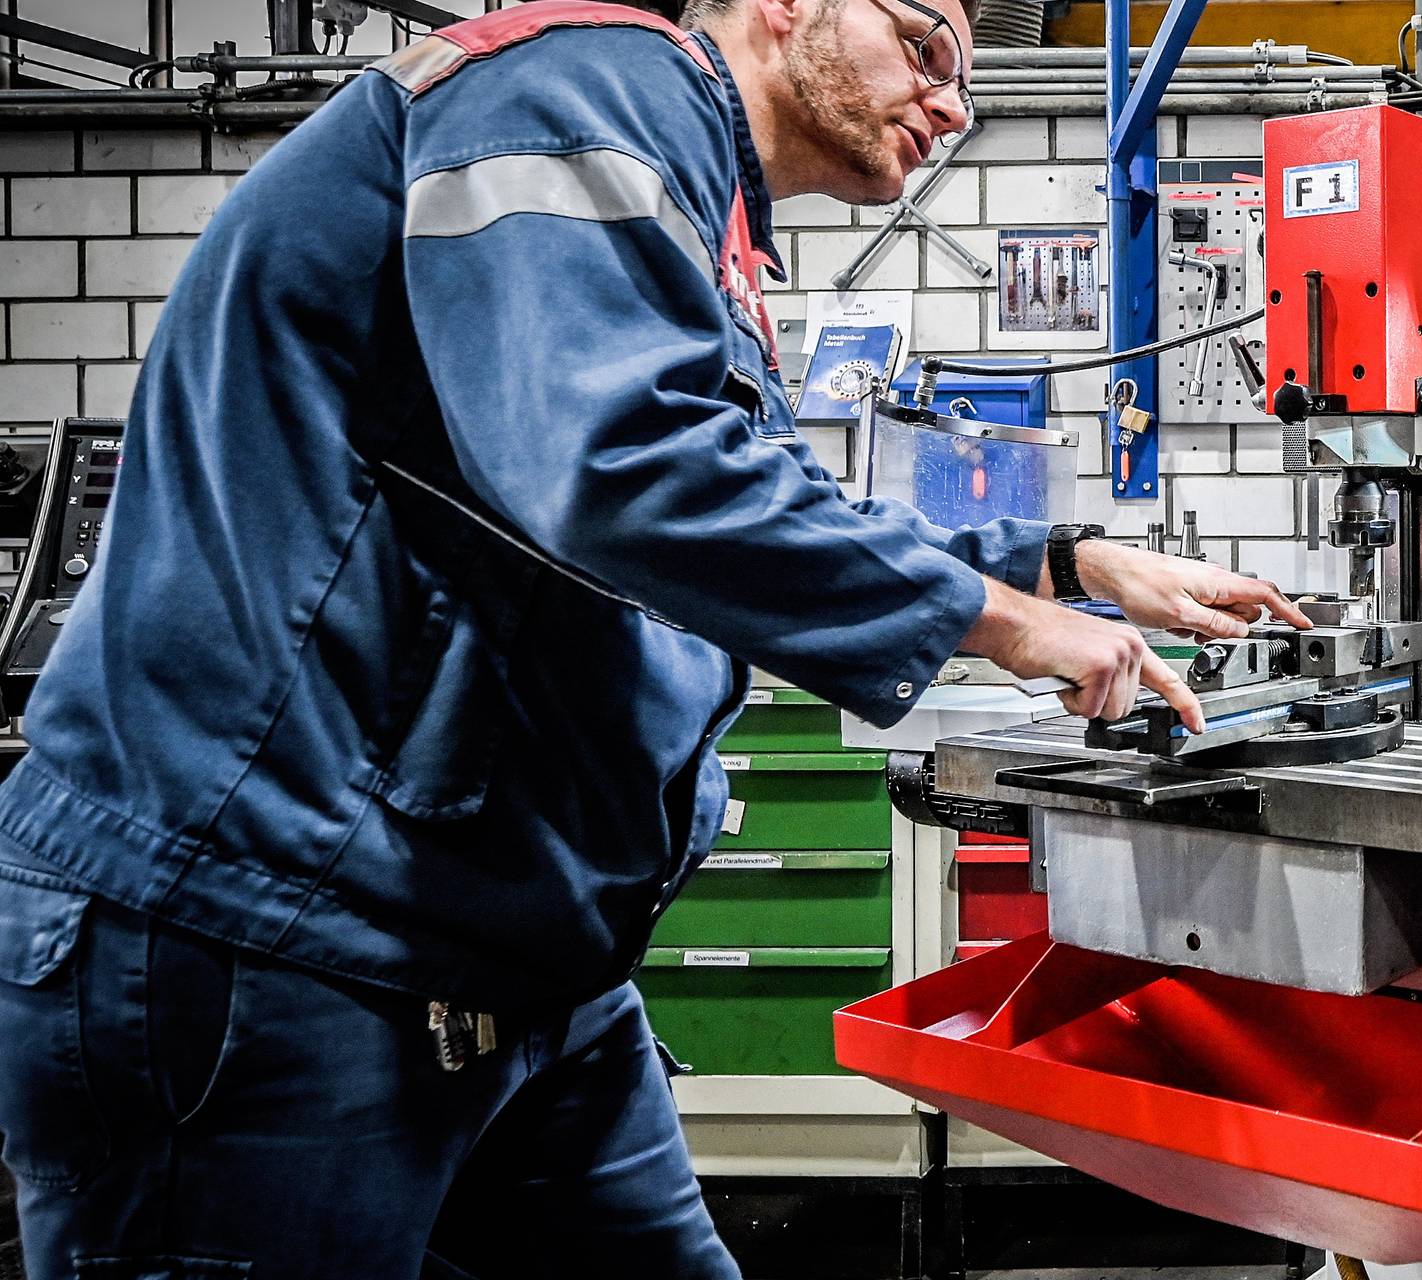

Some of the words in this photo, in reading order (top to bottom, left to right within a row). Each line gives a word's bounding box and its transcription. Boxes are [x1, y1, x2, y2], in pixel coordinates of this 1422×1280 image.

[1295, 176, 1313, 208] F
[1328, 173, 1346, 204] 1
[76, 455, 85, 463] X
[73, 475, 81, 483] Y
[69, 496, 78, 504] Z
[693, 954, 741, 962] Spannelemente
